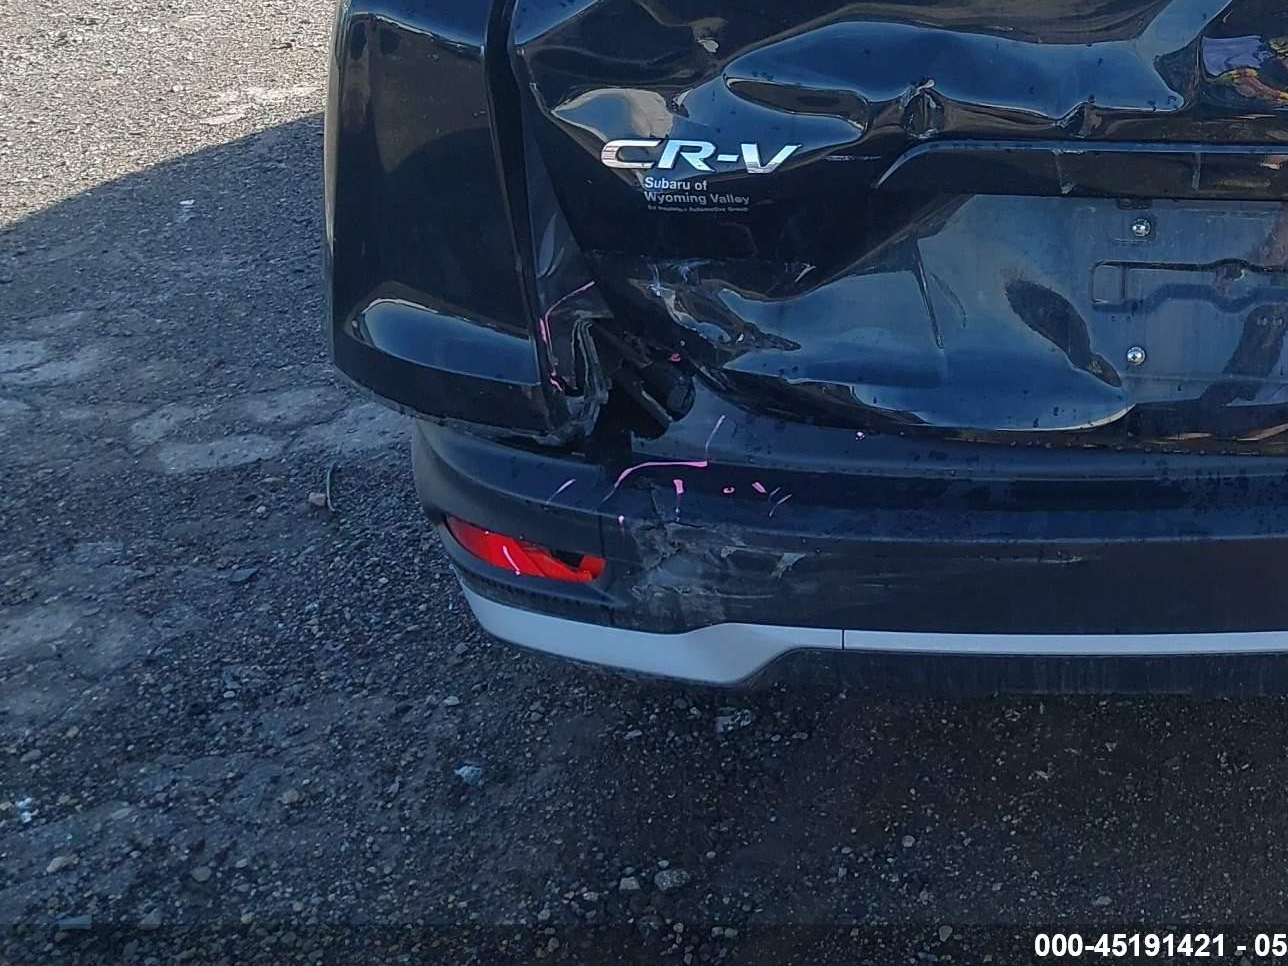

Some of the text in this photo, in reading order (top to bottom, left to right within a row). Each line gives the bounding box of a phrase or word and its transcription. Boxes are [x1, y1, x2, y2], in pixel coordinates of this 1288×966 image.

[601, 139, 802, 174] CR-V
[644, 177, 708, 190] Subaru of
[643, 191, 750, 205] Wyoming Valley
